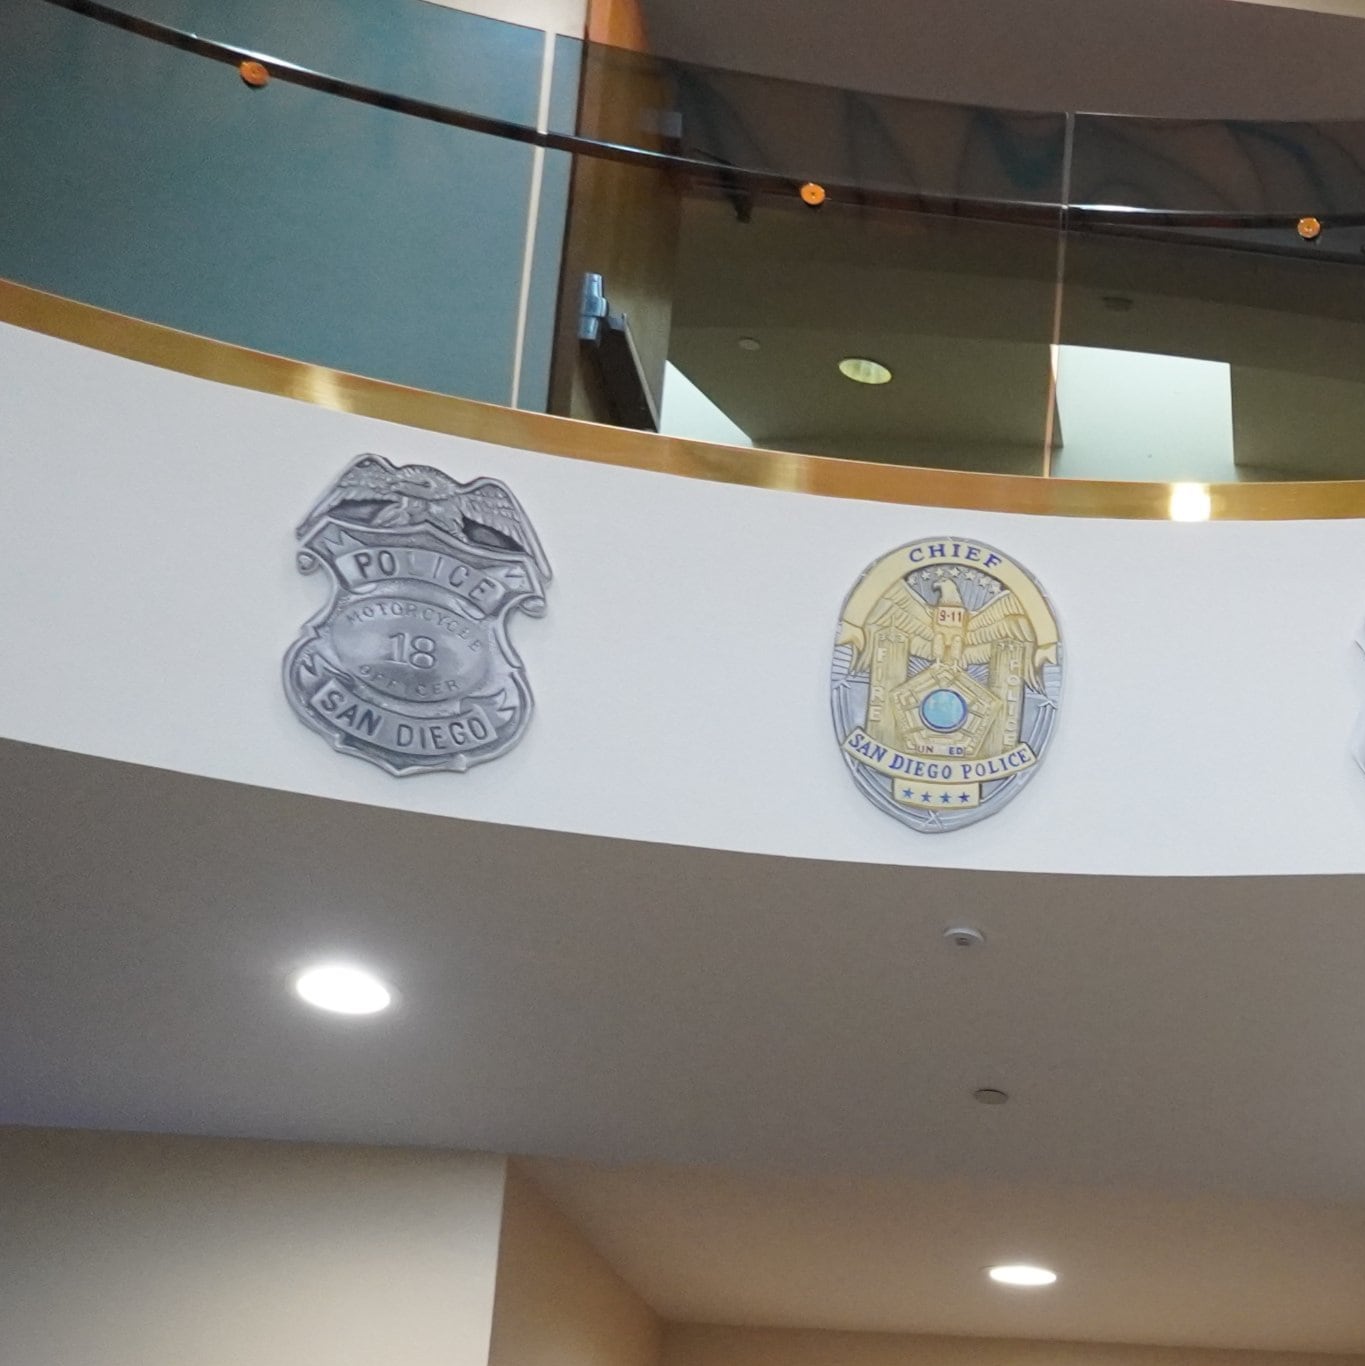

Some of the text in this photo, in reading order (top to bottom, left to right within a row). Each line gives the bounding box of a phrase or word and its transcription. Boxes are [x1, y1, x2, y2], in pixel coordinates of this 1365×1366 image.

[354, 550, 496, 604] POLICE
[909, 543, 1002, 567] CHIEF
[346, 602, 483, 652] MOTORCYCLE
[939, 609, 962, 622] 9-11
[387, 632, 436, 669] 18
[360, 664, 461, 696] OFFCER
[870, 647, 887, 722] FIRE
[1004, 660, 1021, 745] POLICE
[321, 690, 489, 750] SAN DIEGO
[849, 733, 1032, 779] SAN DIEGO POLICE
[918, 745, 965, 755] UNED
